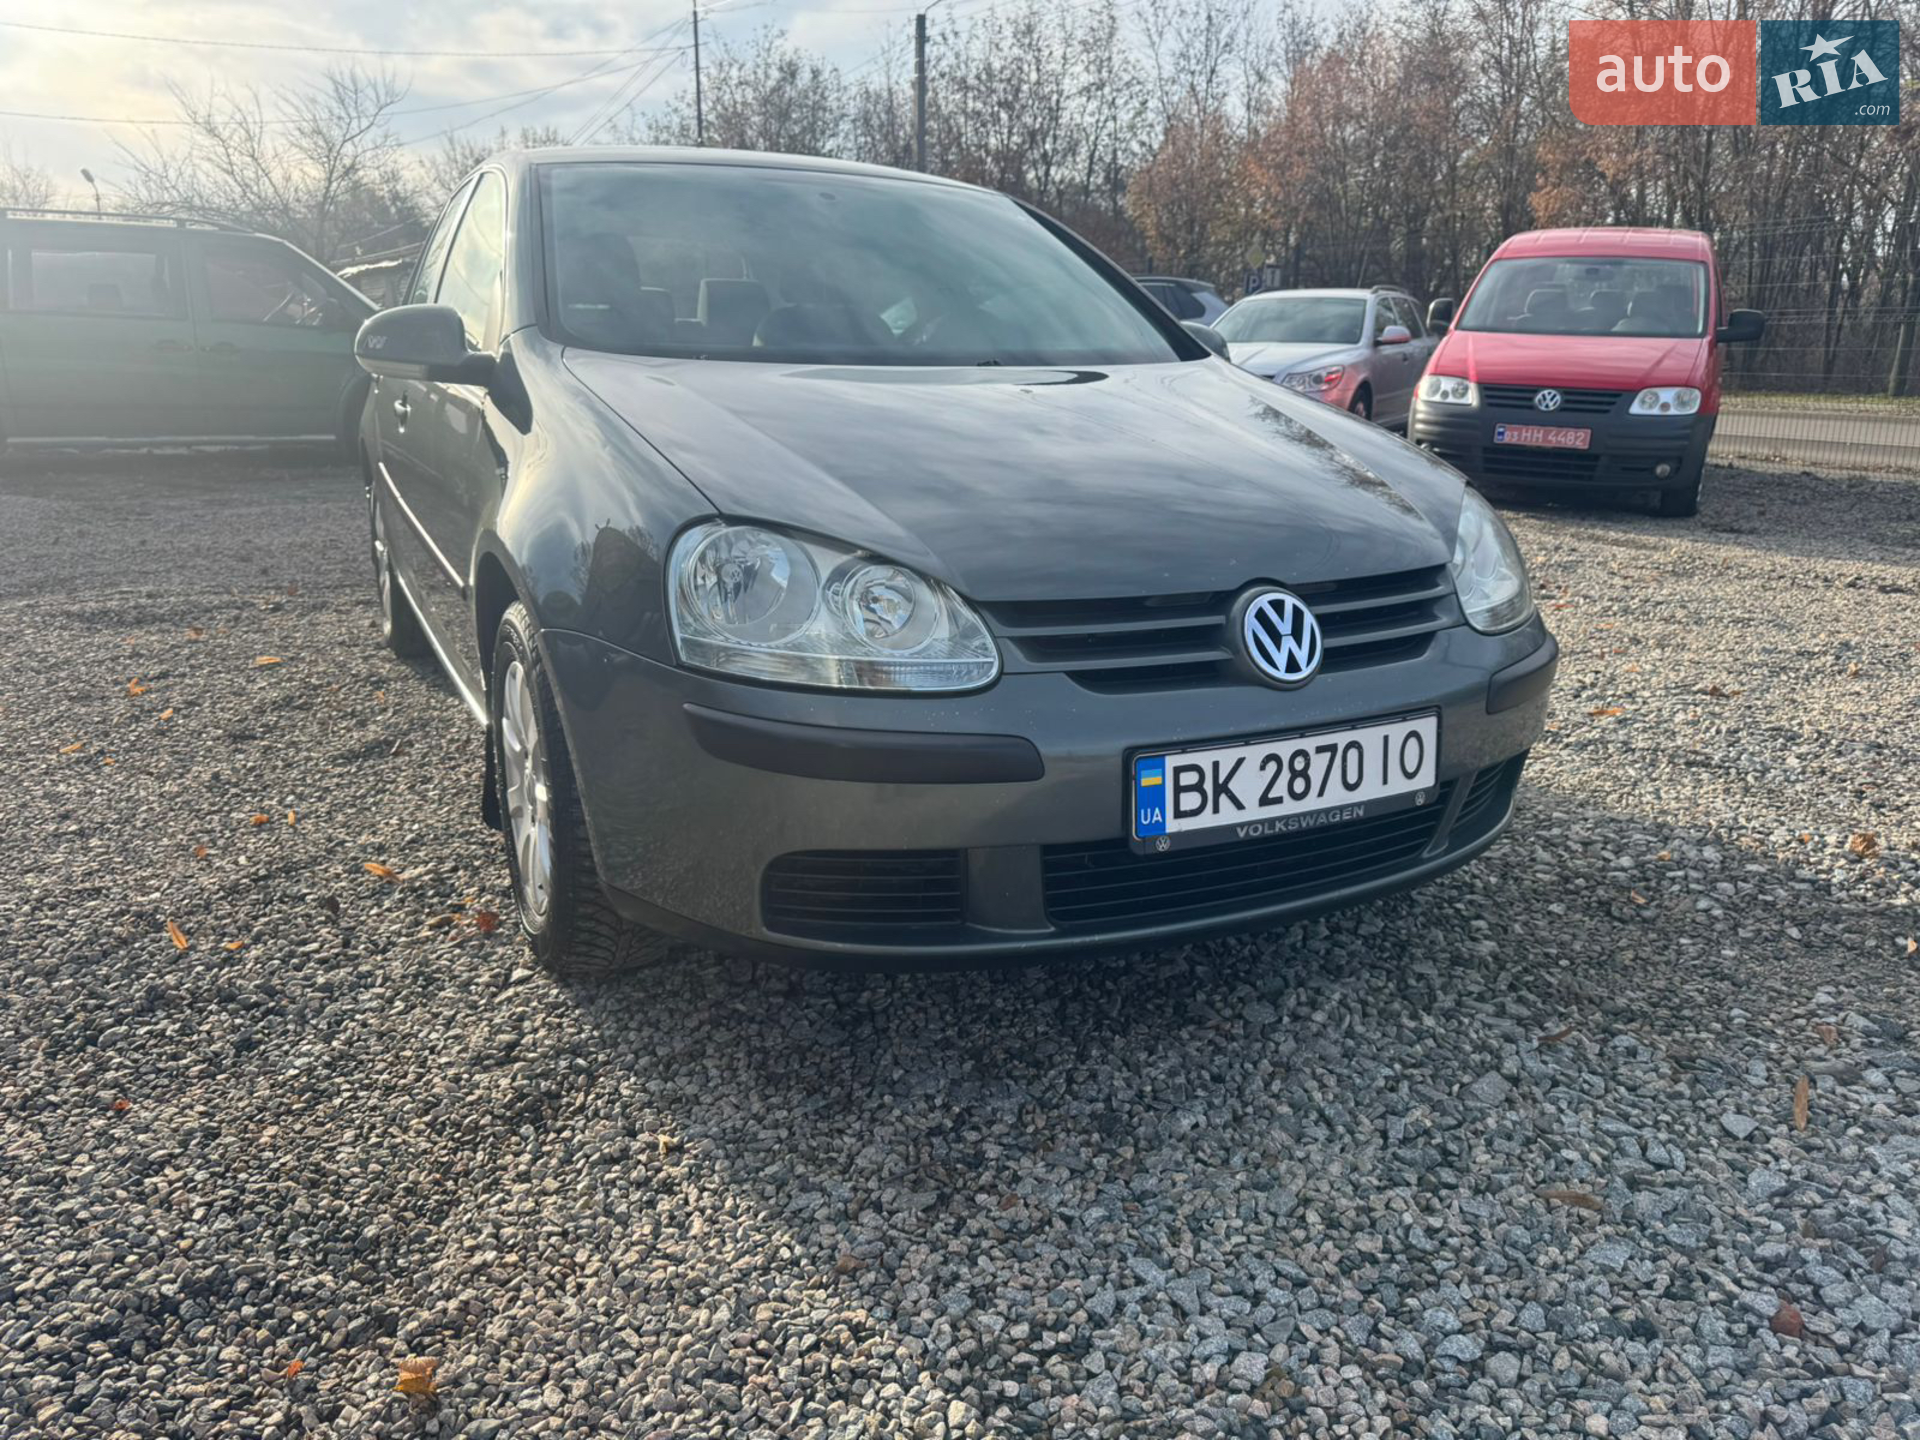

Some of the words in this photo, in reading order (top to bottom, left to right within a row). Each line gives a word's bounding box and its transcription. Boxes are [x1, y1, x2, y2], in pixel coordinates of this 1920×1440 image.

[1548, 430, 1585, 446] 4482
[1172, 756, 1247, 820] BK
[1258, 740, 1364, 807] 2870
[1382, 730, 1424, 786] IO
[1140, 807, 1163, 825] UA
[1236, 805, 1365, 838] VOLKSWAGEN
